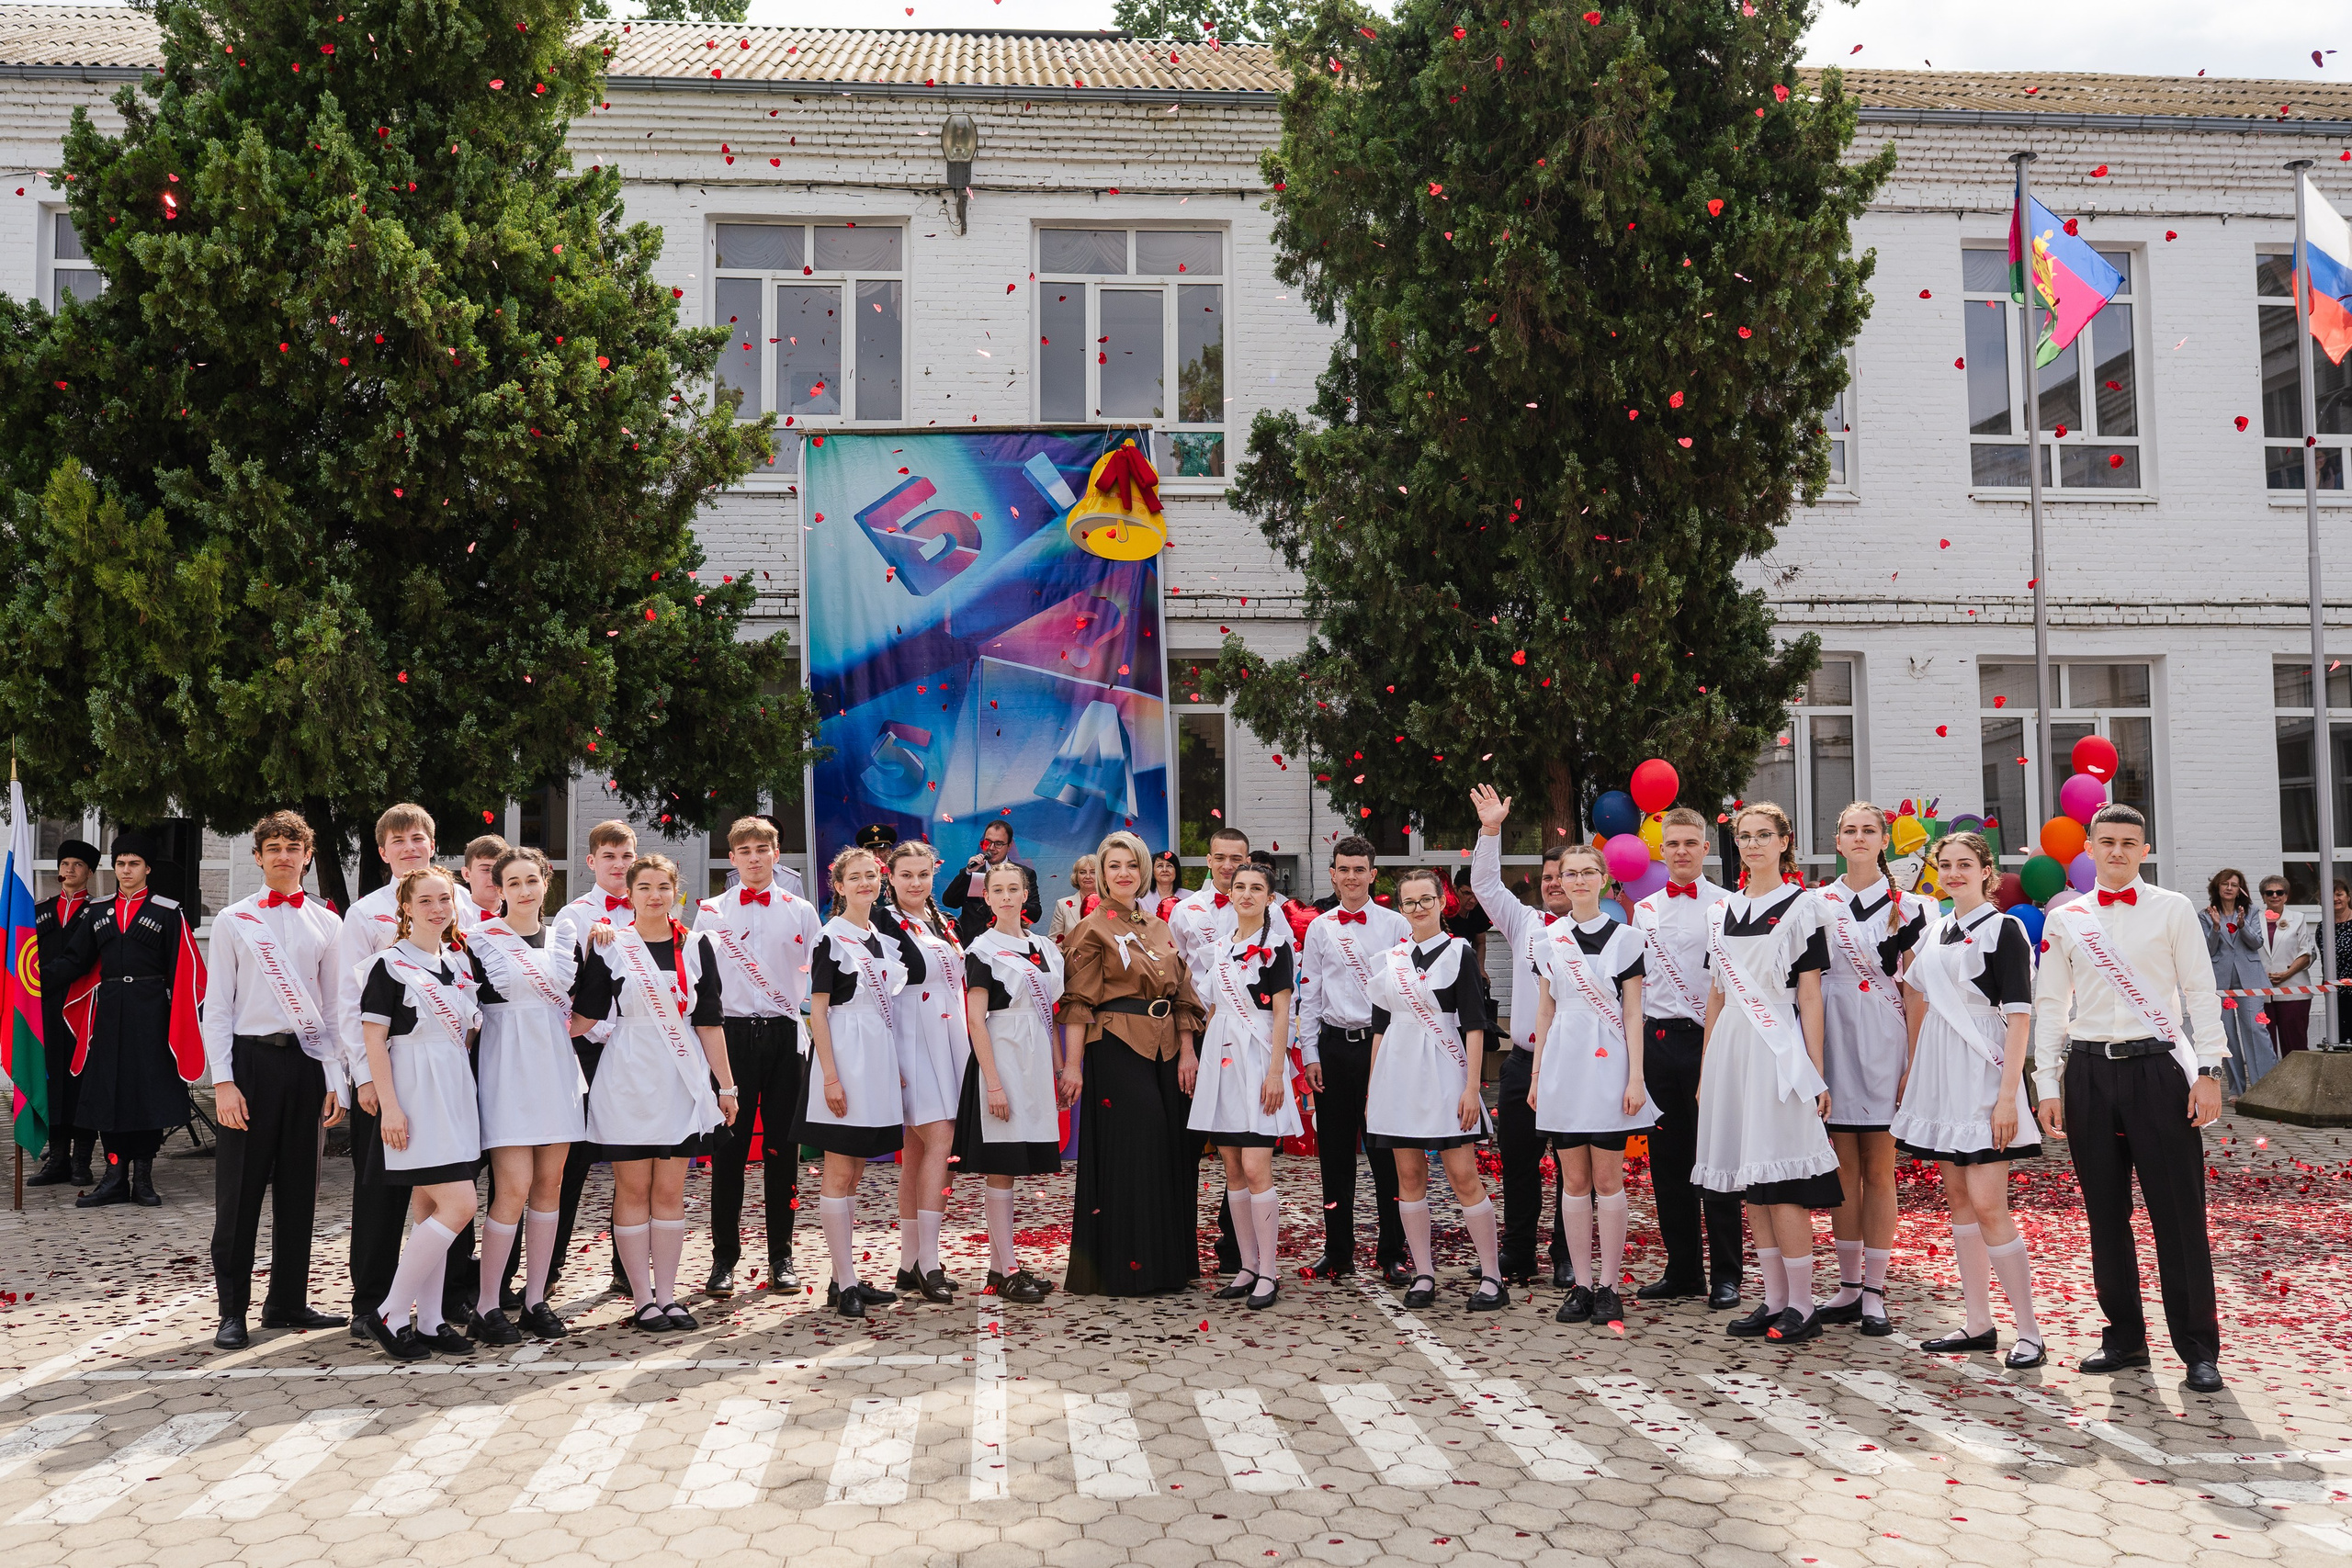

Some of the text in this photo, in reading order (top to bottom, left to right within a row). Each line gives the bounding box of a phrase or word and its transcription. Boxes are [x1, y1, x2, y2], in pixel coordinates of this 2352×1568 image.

[254, 930, 322, 1045] Выпускник 2026
[505, 938, 566, 1008] Выпускница
[714, 919, 797, 1013] Выпускник 2026
[1336, 927, 1368, 986] Выпускн
[1564, 948, 1623, 1030] Выпускница
[1645, 922, 1688, 991] Выпускник
[1837, 908, 1883, 989] Выпускница
[2080, 919, 2177, 1041] Выпускник 2026
[620, 935, 689, 1056] Выпускница 2026
[1396, 960, 1468, 1066] Выпускница 2026
[1744, 997, 1777, 1026] 2026
